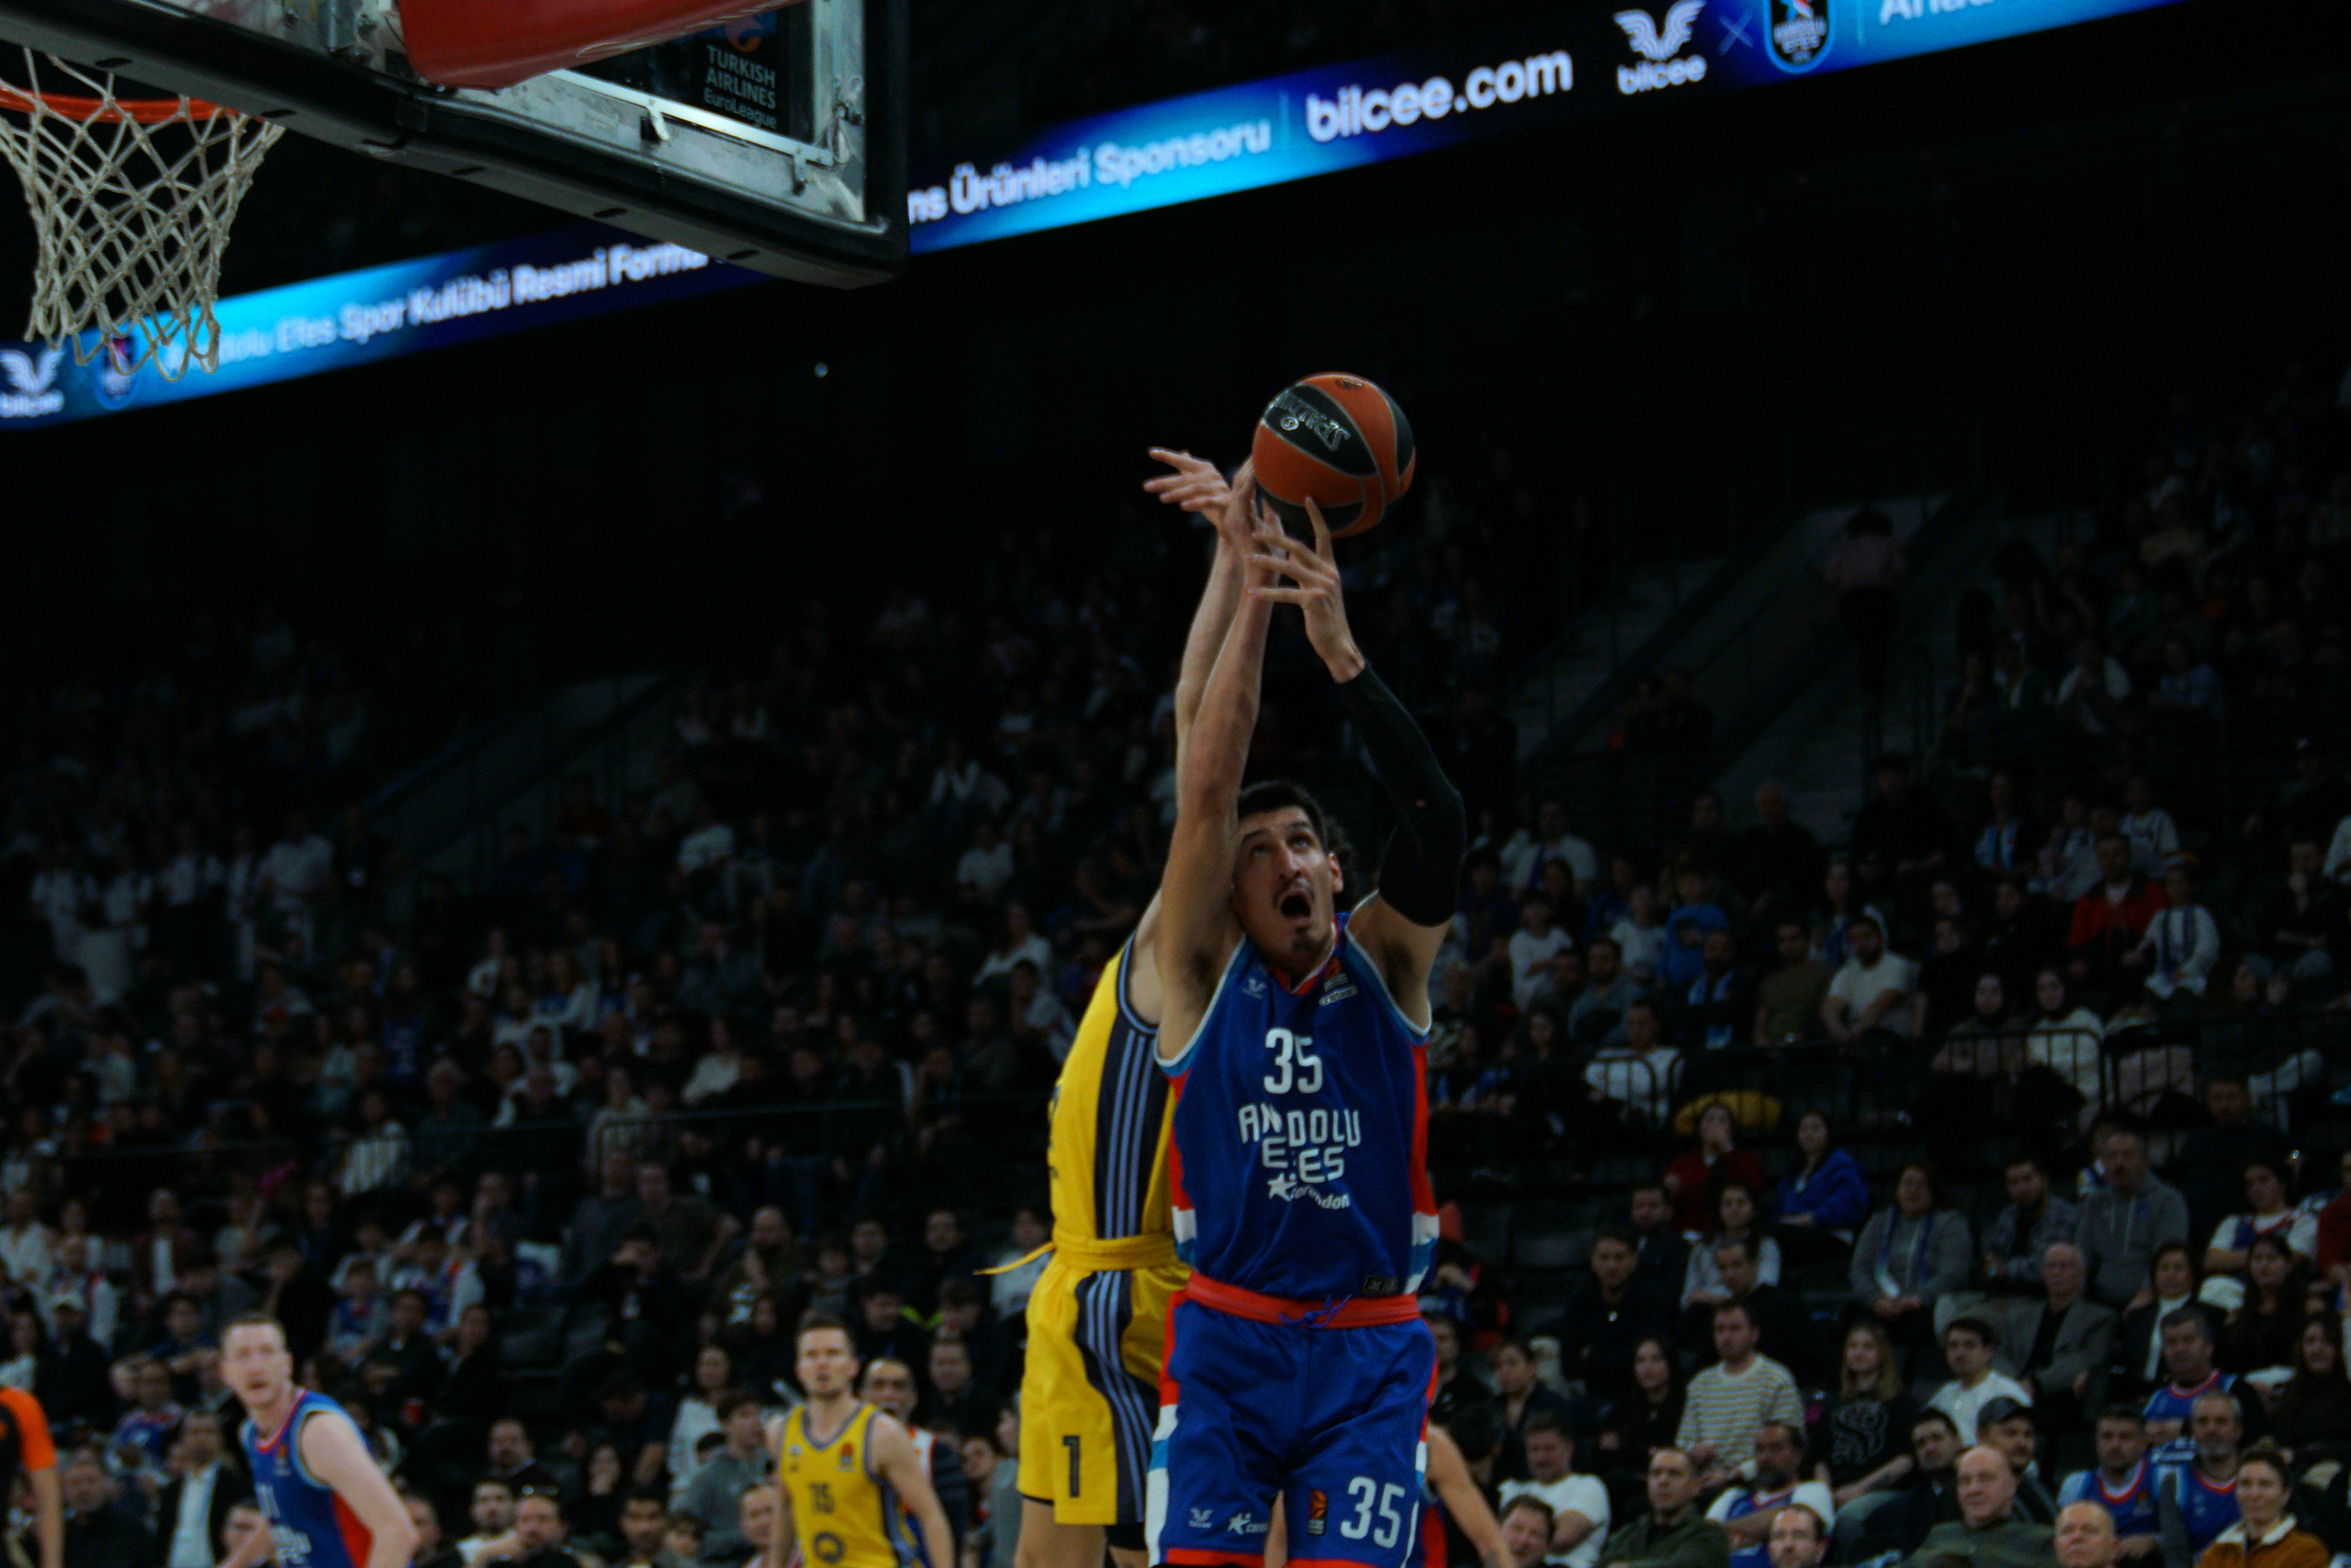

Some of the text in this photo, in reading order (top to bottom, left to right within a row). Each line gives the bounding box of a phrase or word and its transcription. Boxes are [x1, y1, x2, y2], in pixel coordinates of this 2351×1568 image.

[706, 67, 776, 110] AIRLINES
[707, 44, 776, 89] TURKISH
[1617, 54, 1707, 95] bilcee
[1306, 50, 1573, 143] bilcee.com
[339, 298, 408, 345] Spor
[512, 247, 607, 304] Resmi
[950, 146, 1092, 214] Ürünleri
[1093, 119, 1272, 187] Sponsoru
[1264, 1027, 1323, 1095] 35
[1238, 1103, 1361, 1147] ANDOLU
[1261, 1136, 1345, 1184] EES
[1062, 1435, 1081, 1499] 1
[1340, 1476, 1406, 1549] 35
